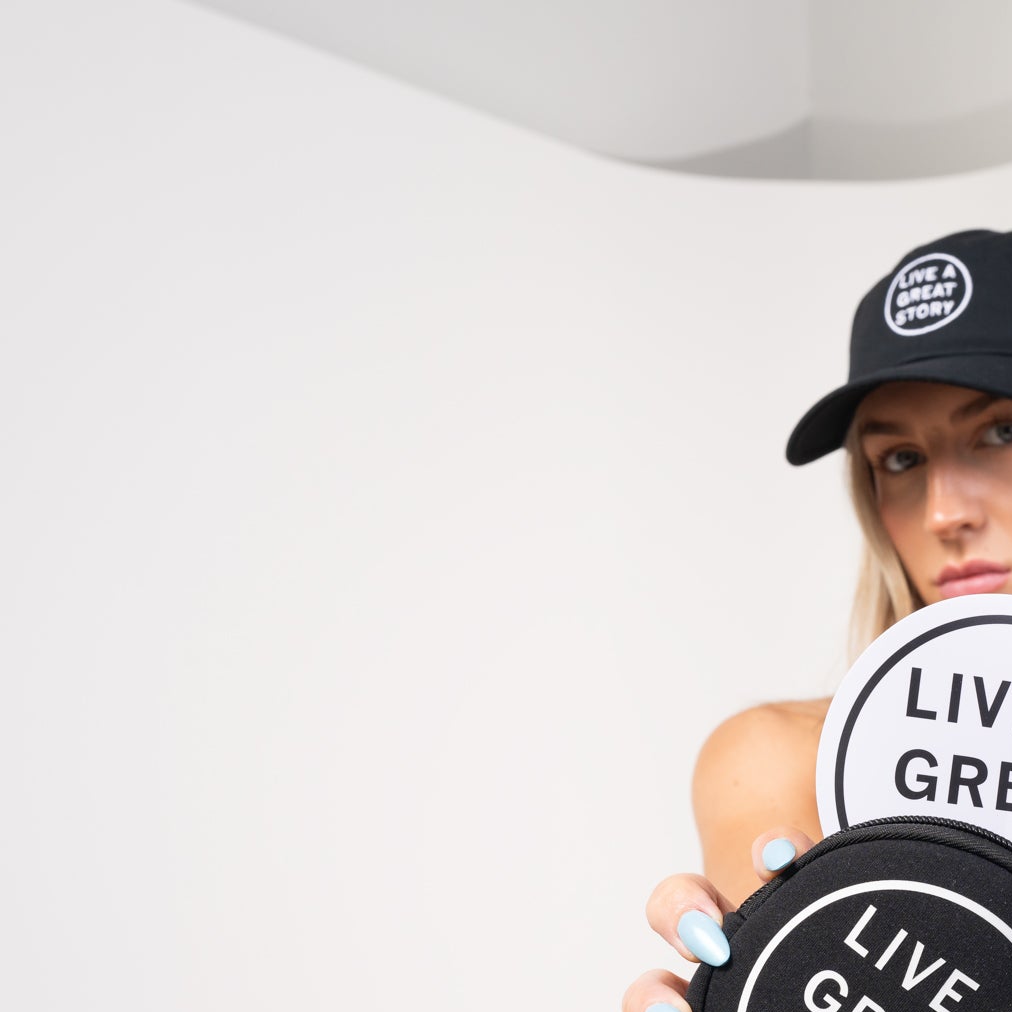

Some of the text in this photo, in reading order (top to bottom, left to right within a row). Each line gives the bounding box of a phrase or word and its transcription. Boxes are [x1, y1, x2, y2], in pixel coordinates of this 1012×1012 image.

[898, 263, 957, 290] LIVE A
[896, 281, 958, 308] GREAT
[894, 300, 955, 326] STORY
